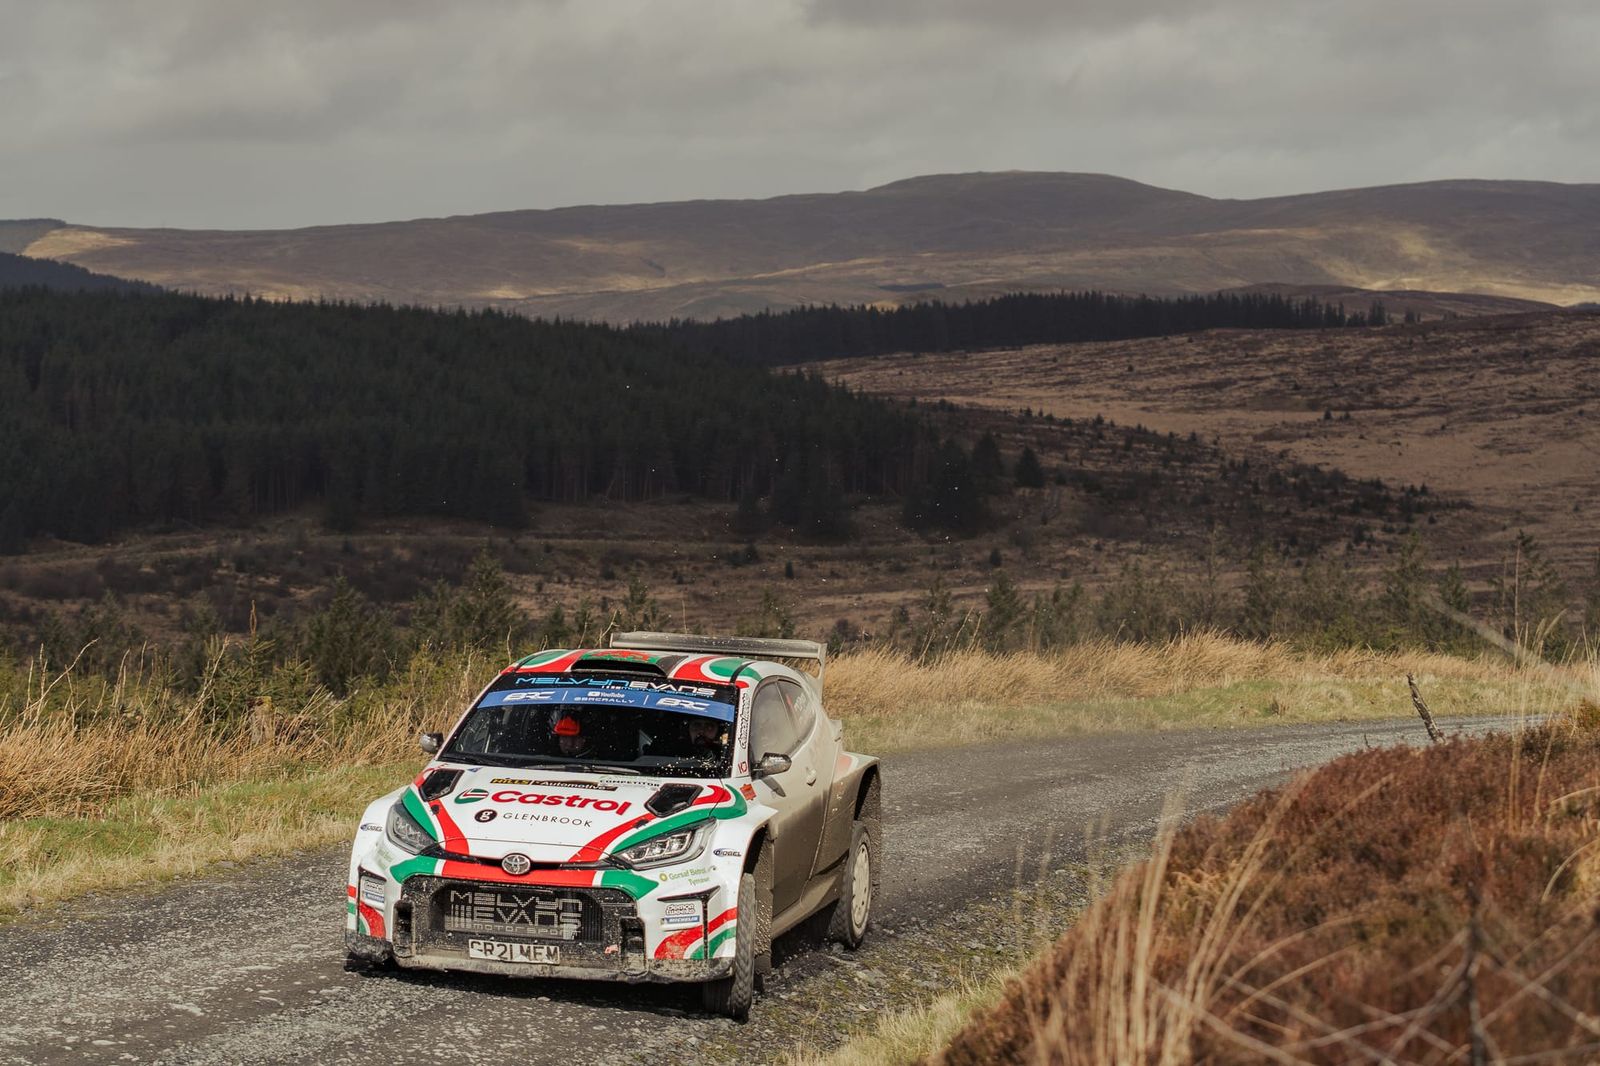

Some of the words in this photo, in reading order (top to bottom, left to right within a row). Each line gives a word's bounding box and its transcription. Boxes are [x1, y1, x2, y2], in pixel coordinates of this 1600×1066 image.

[656, 697, 711, 711] BRC
[491, 790, 632, 816] Castrol
[502, 812, 593, 828] GLENBROOK
